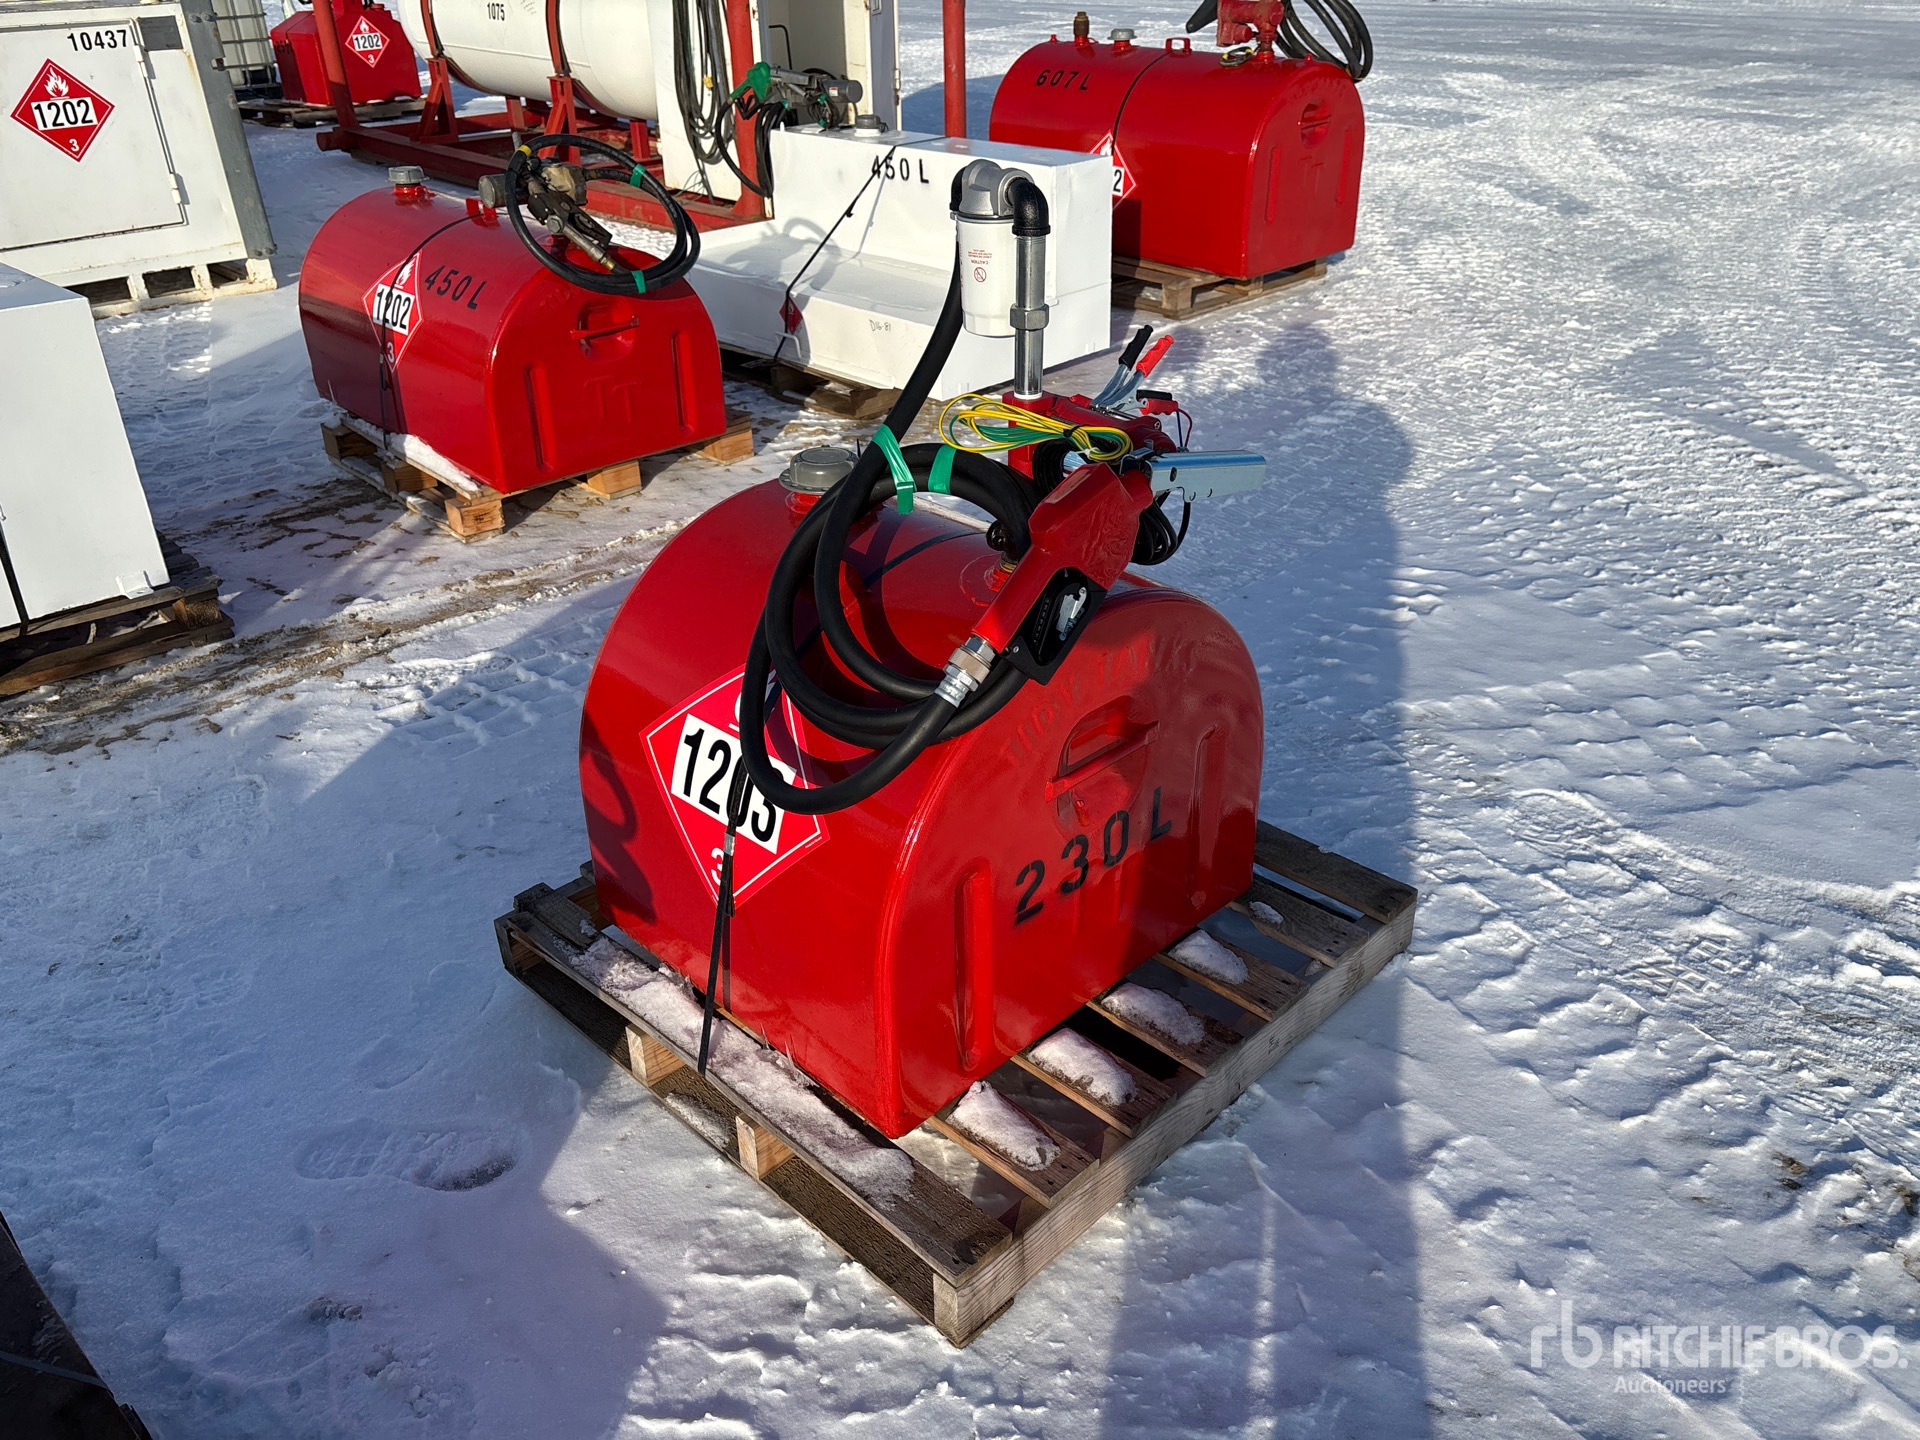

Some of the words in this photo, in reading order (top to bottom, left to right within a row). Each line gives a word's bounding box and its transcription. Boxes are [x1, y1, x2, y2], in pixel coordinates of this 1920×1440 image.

[487, 2, 505, 21] 1075
[67, 29, 127, 52] 10437
[354, 34, 381, 50] 1202
[368, 54, 375, 64] 3
[34, 98, 94, 129] 1202
[69, 138, 79, 152] 3
[919, 158, 929, 184] L
[375, 288, 411, 330] 1202
[386, 341, 395, 364] 3
[683, 728, 785, 843] 1203
